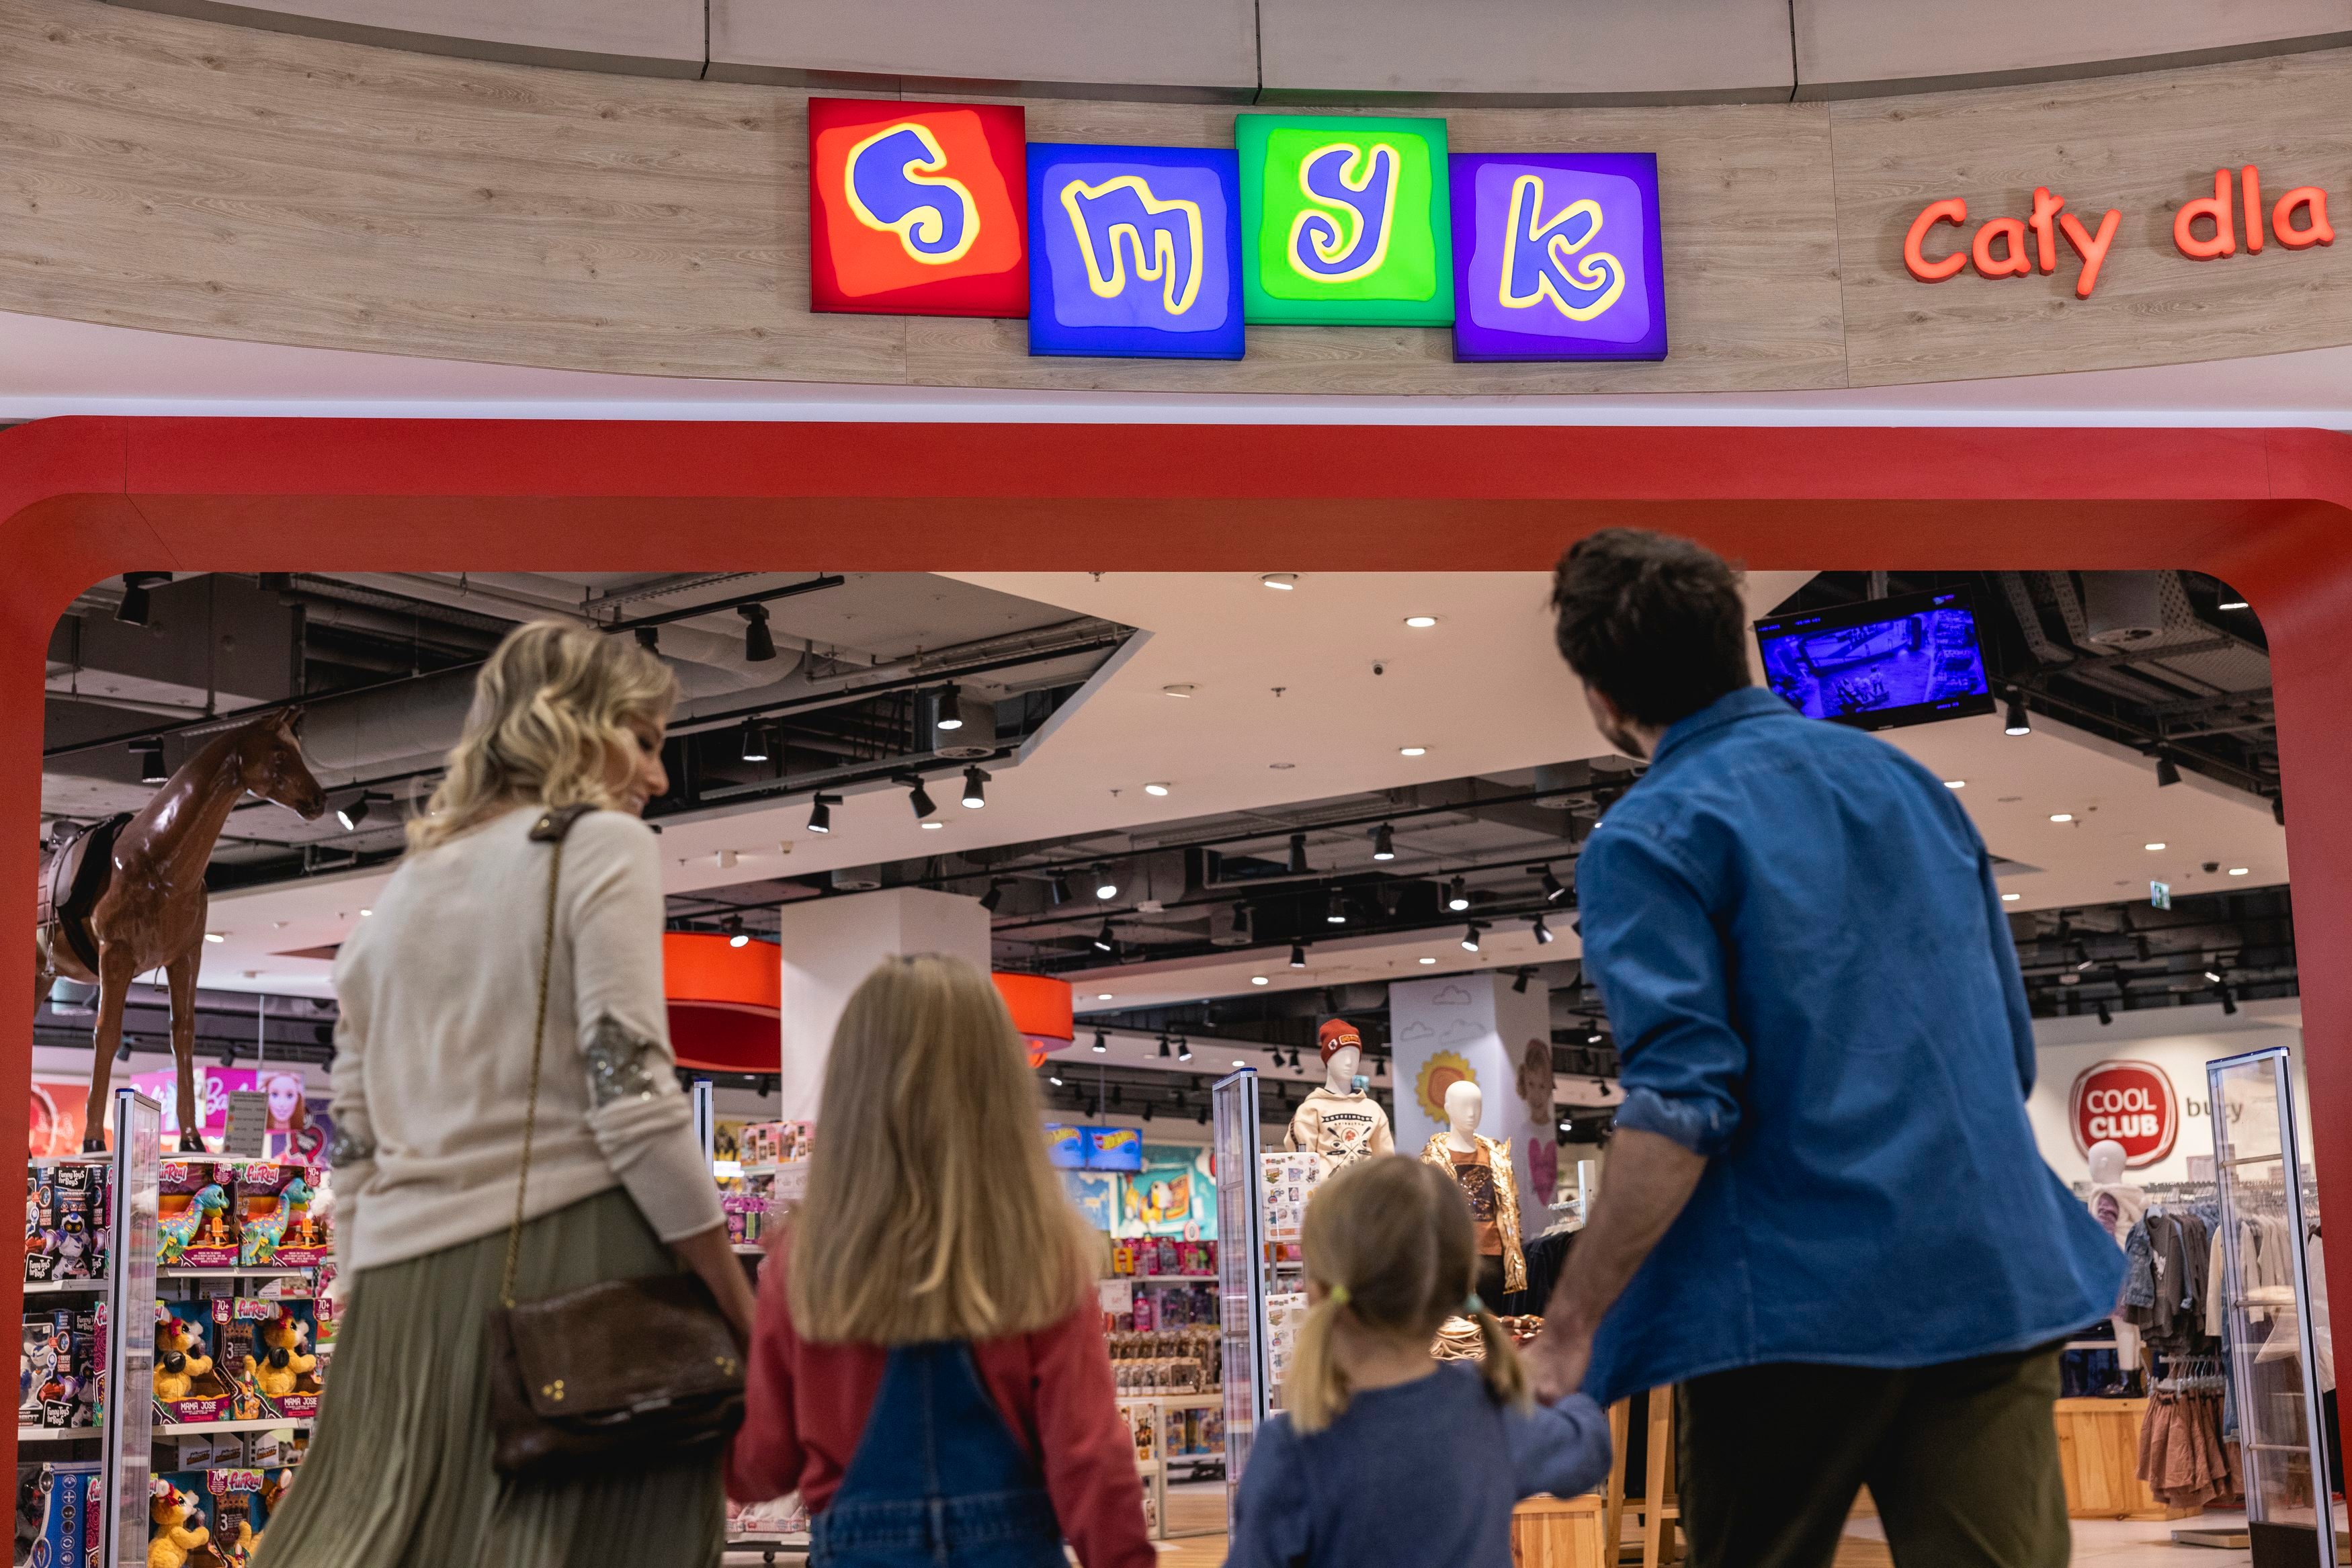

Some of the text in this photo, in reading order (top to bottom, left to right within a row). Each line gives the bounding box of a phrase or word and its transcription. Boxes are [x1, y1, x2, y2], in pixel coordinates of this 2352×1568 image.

[1904, 165, 2335, 300] Cały dla
[2087, 1088, 2158, 1114] COOL
[2088, 1113, 2159, 1139] CLUB
[58, 1170, 73, 1179] Funny
[216, 1300, 229, 1311] 70+
[318, 1299, 330, 1310] 70+
[181, 1401, 216, 1410] MAMA JOSIE
[284, 1397, 317, 1406] MAMA JOSIE
